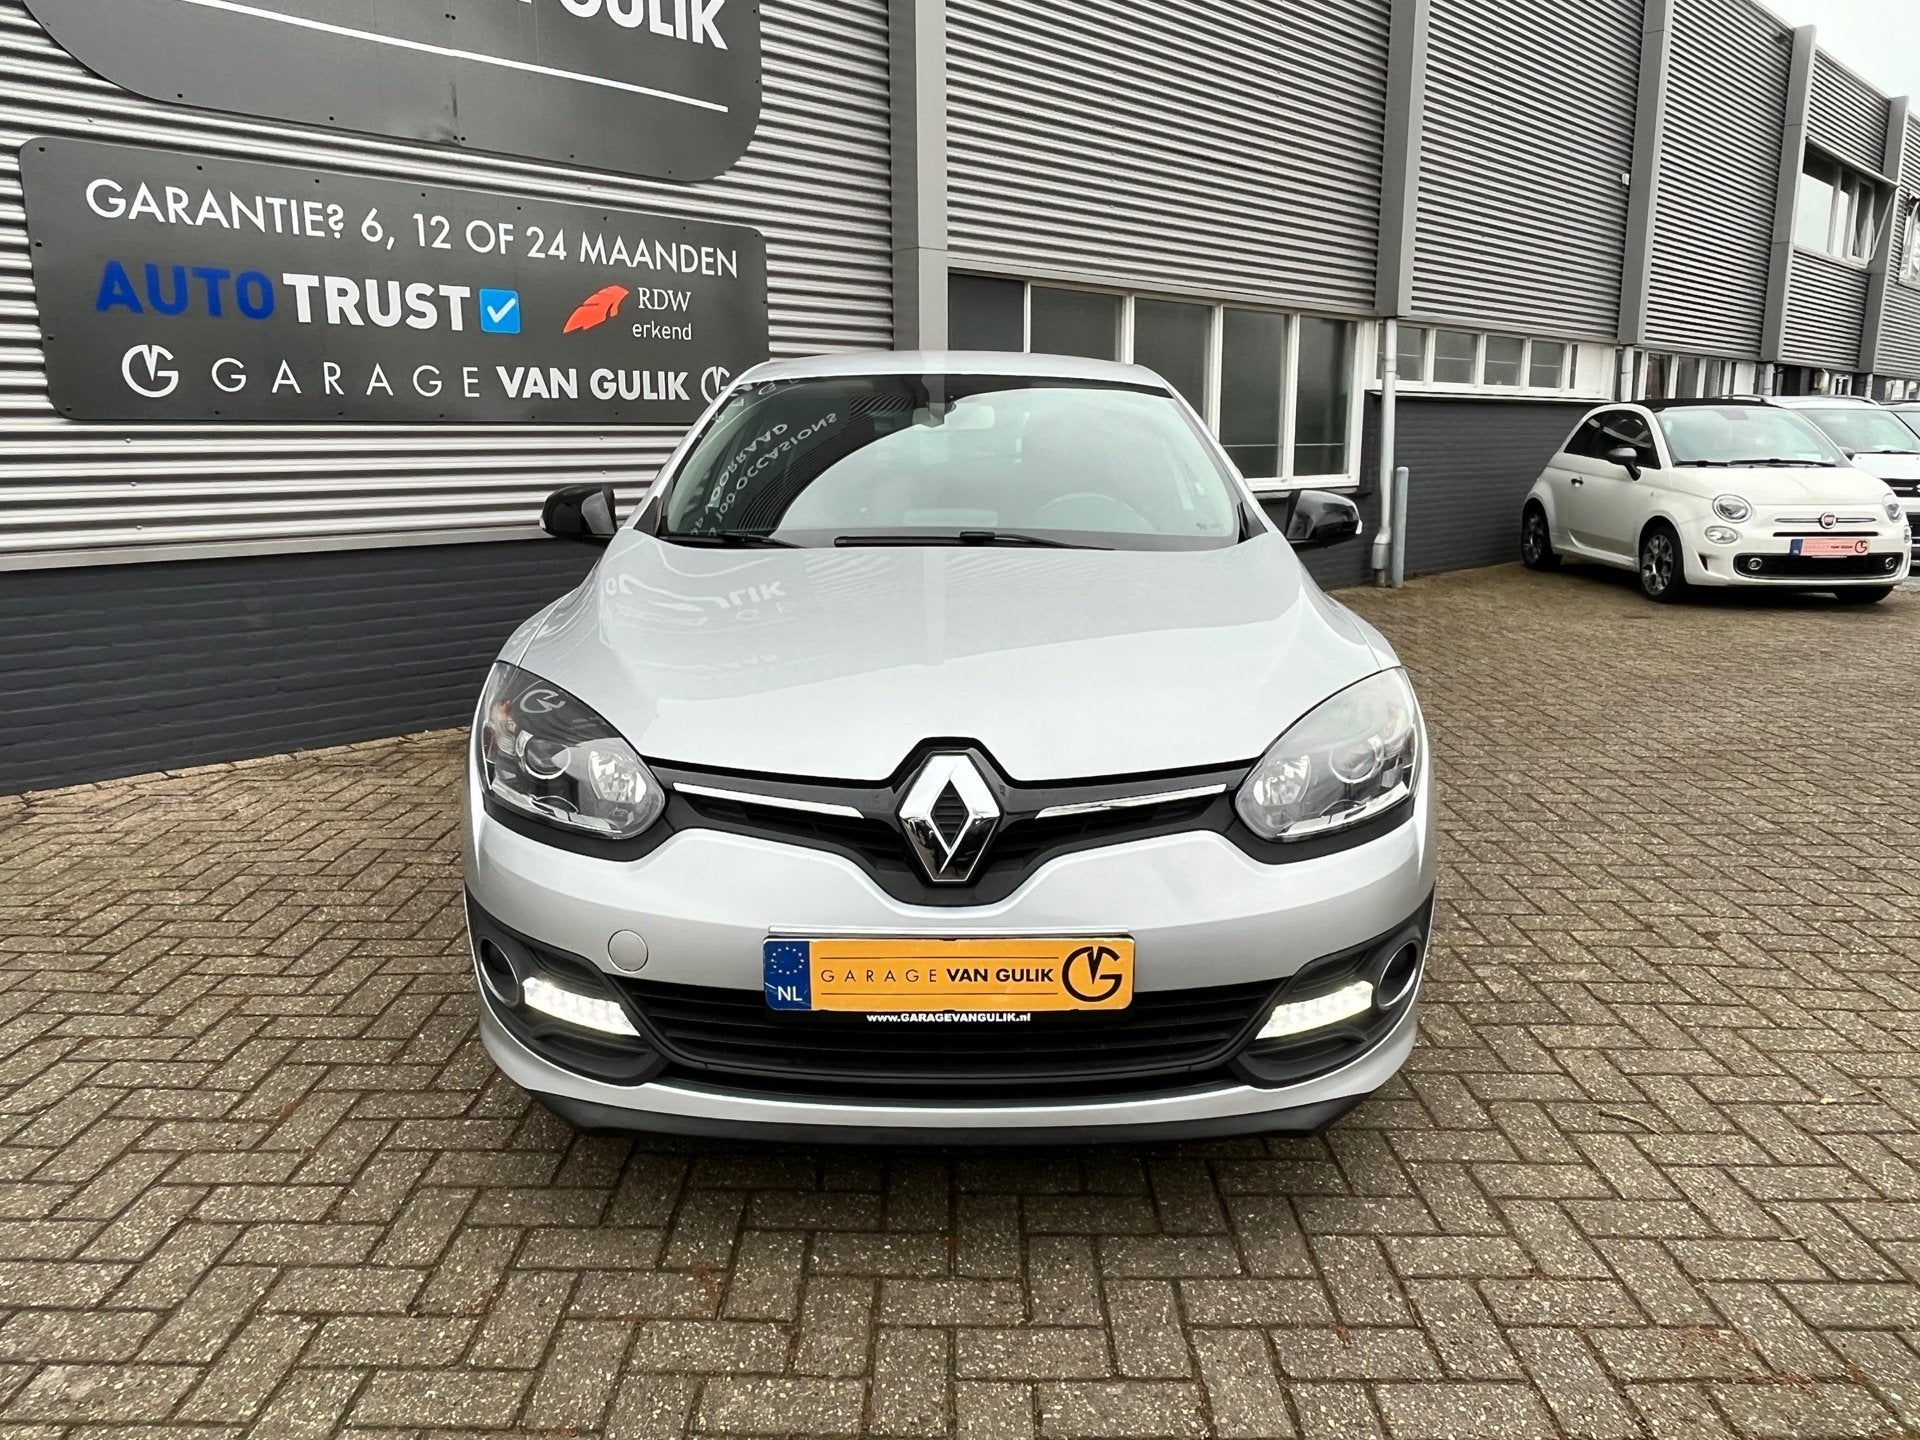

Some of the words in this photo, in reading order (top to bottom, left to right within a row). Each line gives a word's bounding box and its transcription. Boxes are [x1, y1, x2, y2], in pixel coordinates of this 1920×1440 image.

[85, 178, 344, 239] GARANTIE?
[361, 207, 395, 250] 6,
[413, 213, 451, 249] 12
[465, 219, 514, 255] OF
[526, 226, 567, 261] 24
[579, 231, 737, 279] MAANDEN
[637, 286, 692, 312] RDW
[632, 320, 693, 340] erkend
[211, 357, 480, 397] GARAGE
[495, 366, 578, 399] VAN
[590, 368, 690, 400] GULIK
[820, 969, 937, 982] GARAGE
[946, 968, 988, 982] VAN
[995, 968, 1054, 983] GULIK
[777, 985, 803, 1001] NL
[866, 1012, 1031, 1023] www.GARAGEVANGULIK.nl
